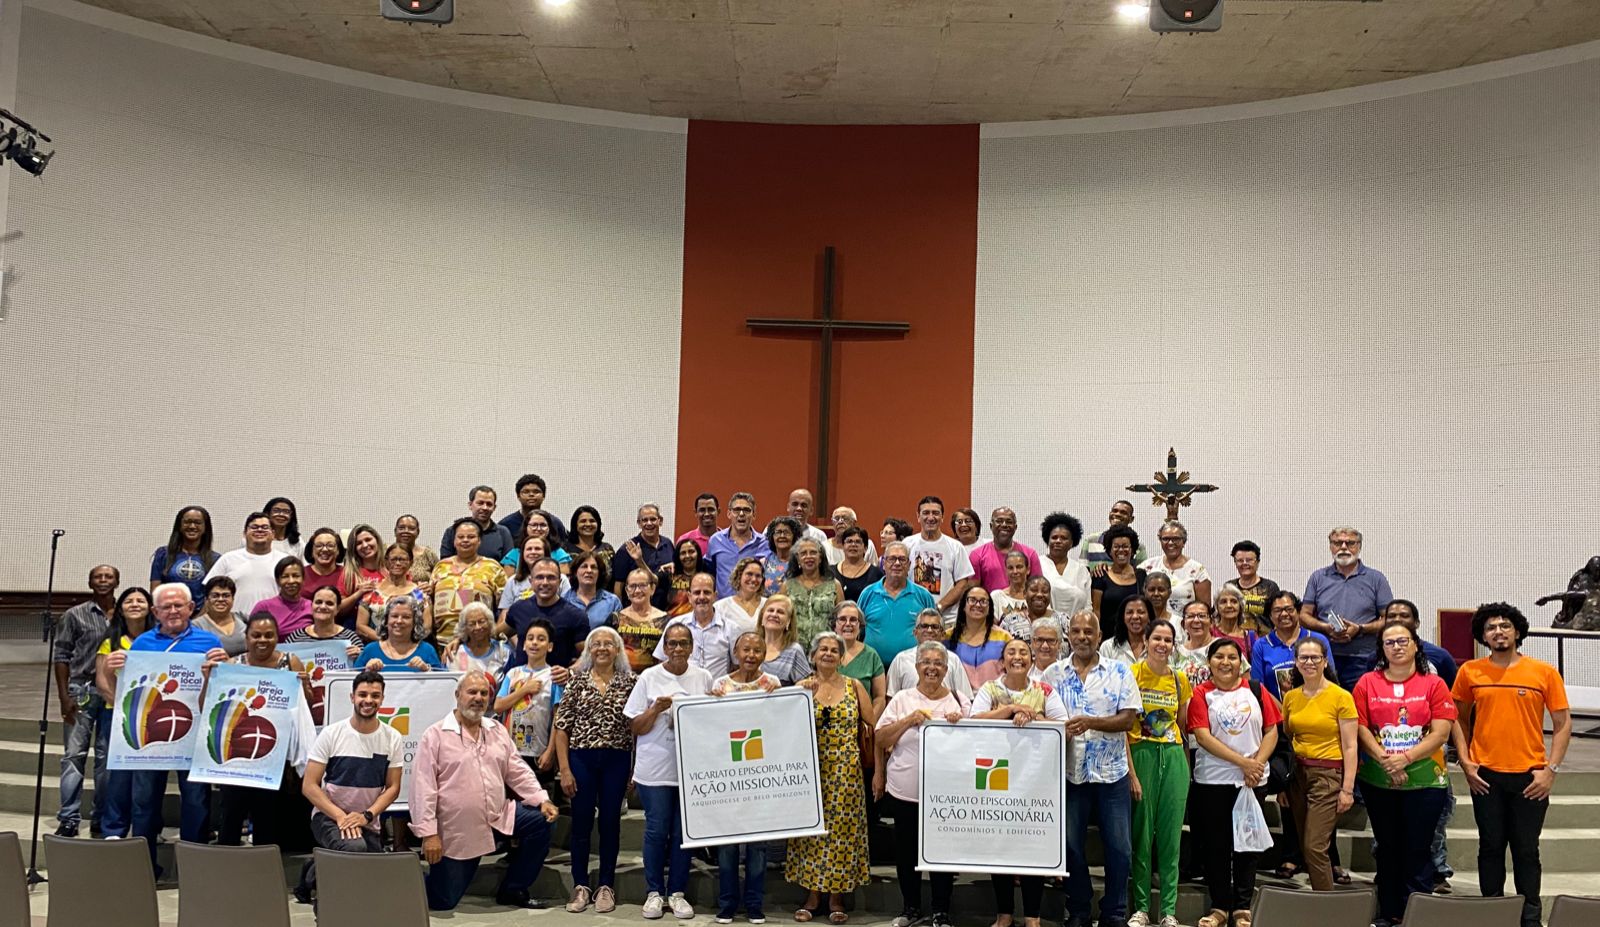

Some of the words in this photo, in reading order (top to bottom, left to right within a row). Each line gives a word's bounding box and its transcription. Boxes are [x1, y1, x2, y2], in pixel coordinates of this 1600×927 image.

[315, 657, 338, 666] Igreja
[169, 670, 195, 678] Igreja
[257, 685, 284, 695] Igreja
[268, 694, 290, 703] local
[1394, 730, 1419, 741] alegria
[1384, 739, 1391, 747] da
[689, 768, 736, 780] VICARIATO
[738, 764, 783, 776] EPISCOPAL
[786, 761, 808, 771] PARA
[690, 781, 726, 798] AÇÃO
[730, 772, 810, 792] MISSIONÁRIA
[773, 790, 811, 799] HORIZONTE
[929, 794, 978, 805] VICARIATO
[980, 796, 1028, 807] EPISCOPAL
[1031, 798, 1054, 808] PARA
[929, 805, 967, 822] AÇÃO
[970, 808, 1054, 823] MISSIONÁRIA
[937, 826, 995, 834] CONDOMÍNIOS
[1006, 828, 1046, 836] EDIFÍCIOS
